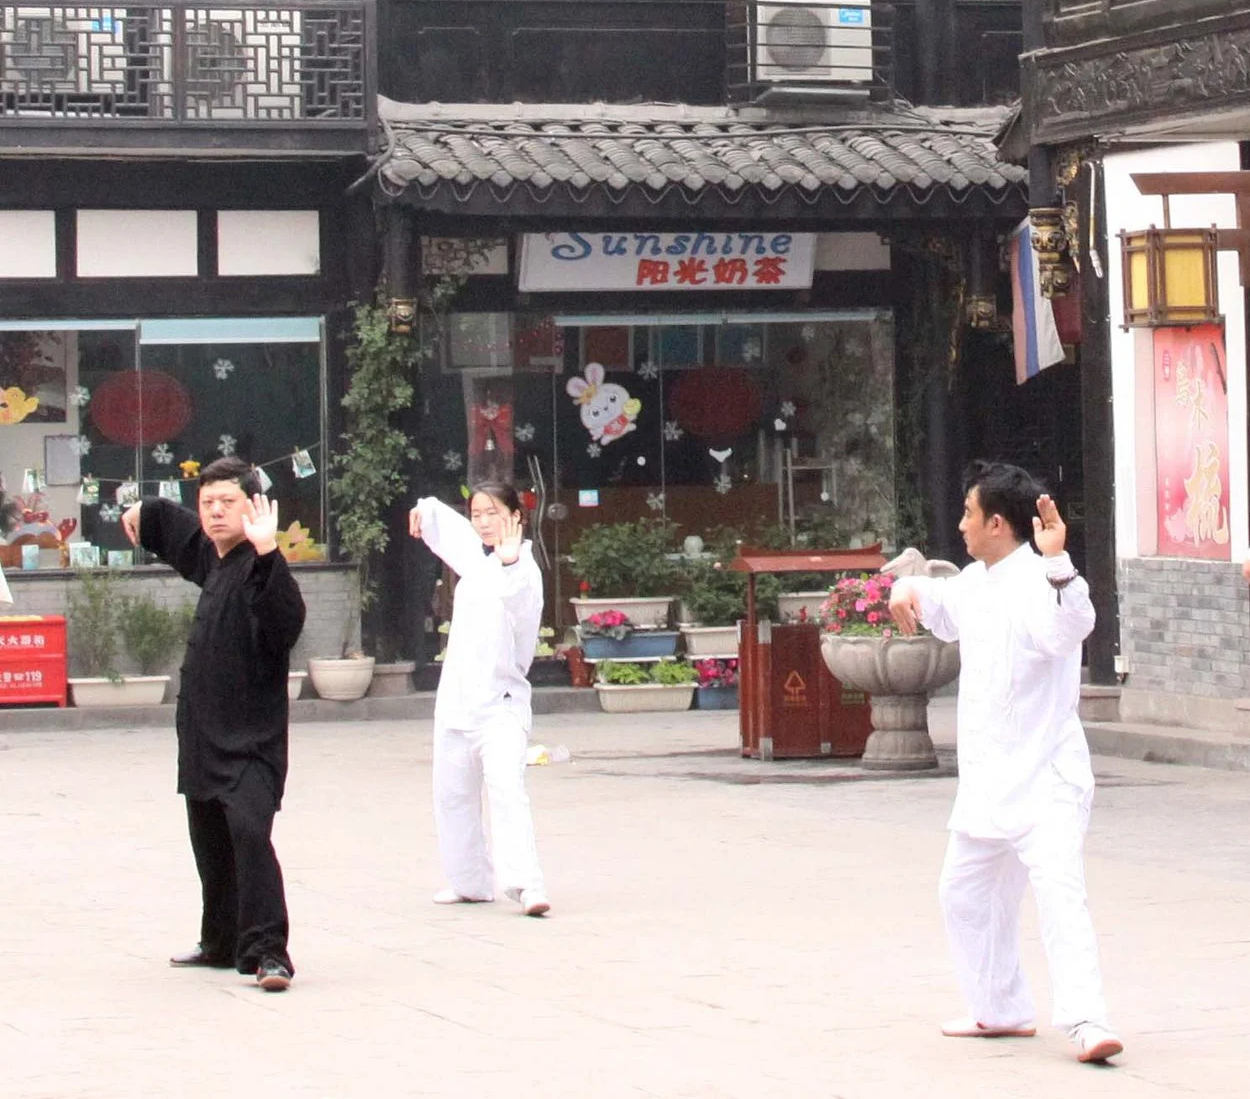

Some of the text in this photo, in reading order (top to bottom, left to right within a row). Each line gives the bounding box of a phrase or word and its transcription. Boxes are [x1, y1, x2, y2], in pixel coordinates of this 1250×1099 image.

[551, 232, 793, 261] Sunshine
[636, 256, 786, 286] 阳光奶茶
[25, 670, 43, 683] 119
